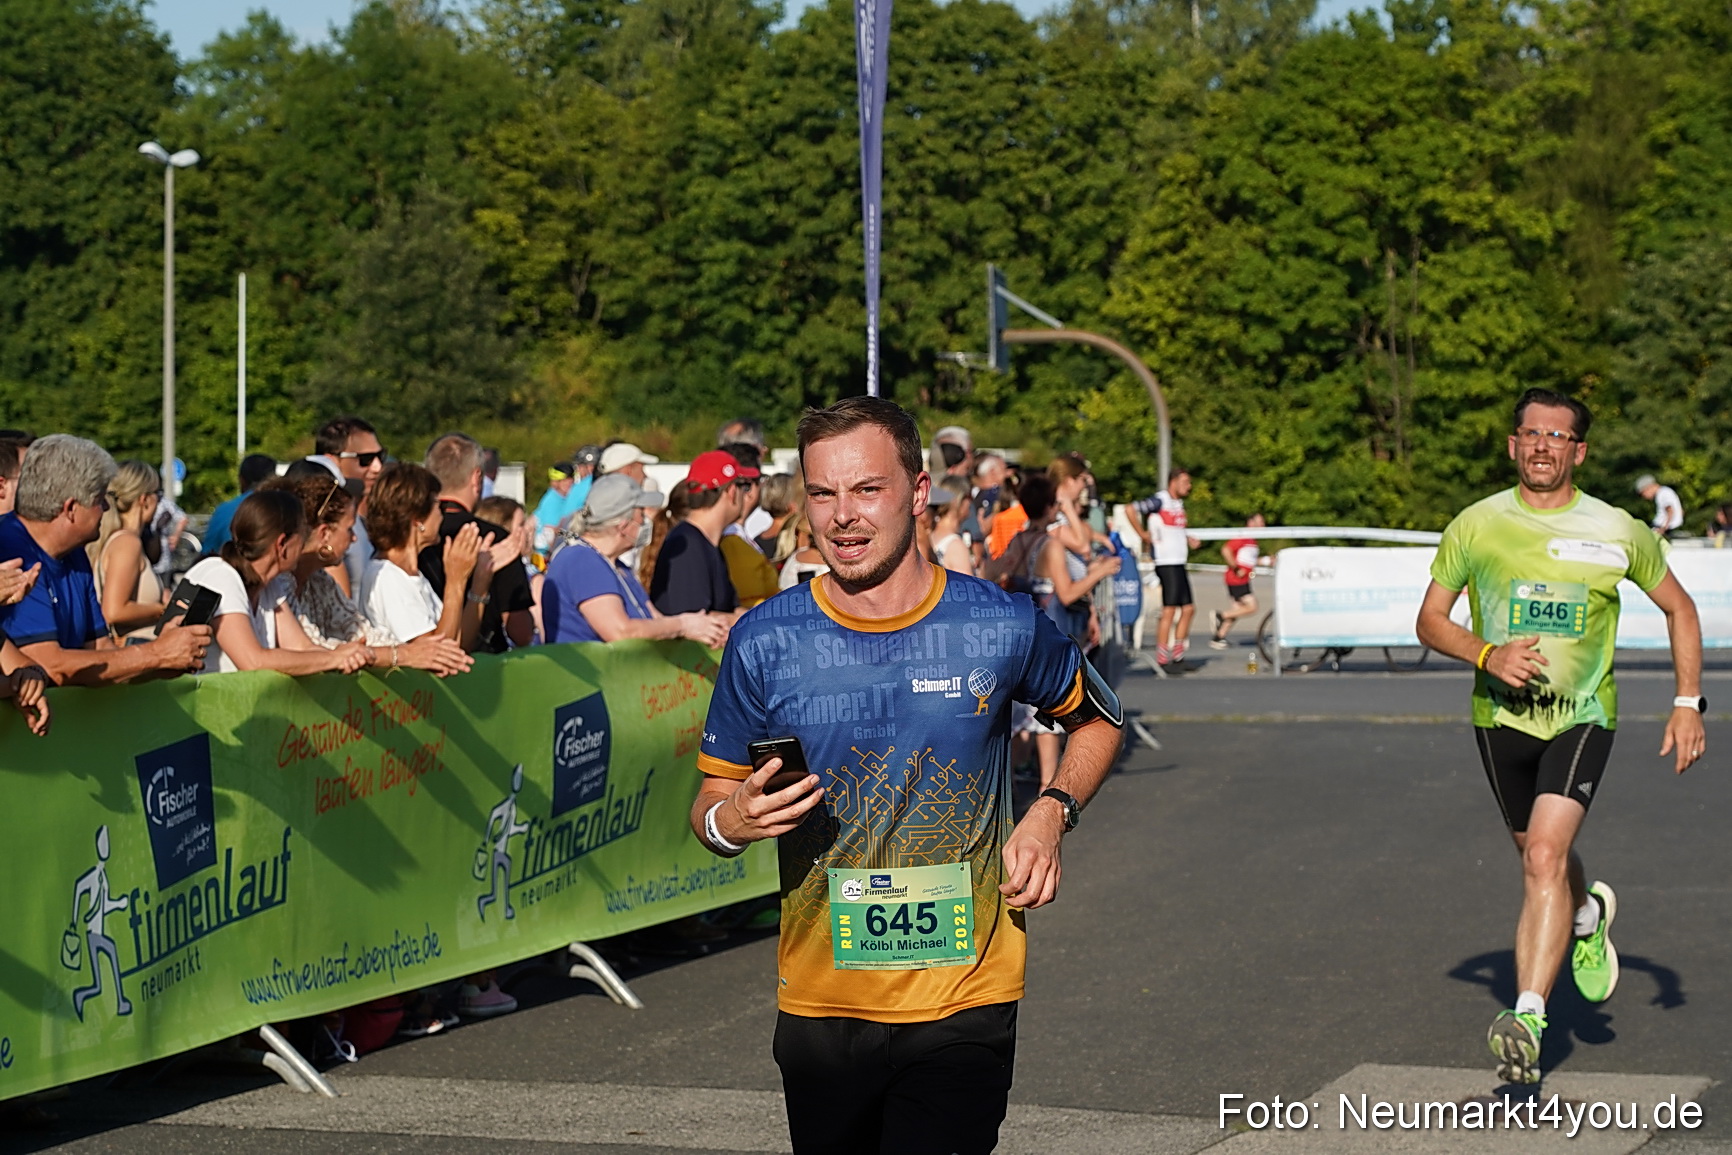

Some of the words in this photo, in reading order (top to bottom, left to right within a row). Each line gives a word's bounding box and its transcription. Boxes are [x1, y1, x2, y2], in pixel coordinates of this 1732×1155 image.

[970, 605, 1016, 618] GmbH
[1529, 600, 1568, 620] 646
[814, 623, 950, 670] Schmer.IT
[911, 676, 962, 693] Schmer.IT
[767, 682, 898, 726] Schmer.IT
[278, 696, 365, 768] Gesunde
[370, 690, 434, 736] Firmen
[563, 730, 605, 759] Fischer
[853, 723, 897, 740] GmbH
[315, 756, 374, 816] laufen
[380, 723, 447, 797] länger!
[158, 783, 199, 817] Fischer
[522, 768, 654, 880] firmenlauf
[129, 826, 292, 967] firmenlauf
[521, 862, 577, 909] neumarkt
[865, 886, 908, 896] Firmenlauf
[839, 915, 853, 949] RUN
[866, 902, 938, 937] 645
[954, 904, 968, 950] 2022
[860, 939, 893, 951] Kölbl
[898, 937, 947, 950] Michael
[141, 946, 202, 1002] neumarkt
